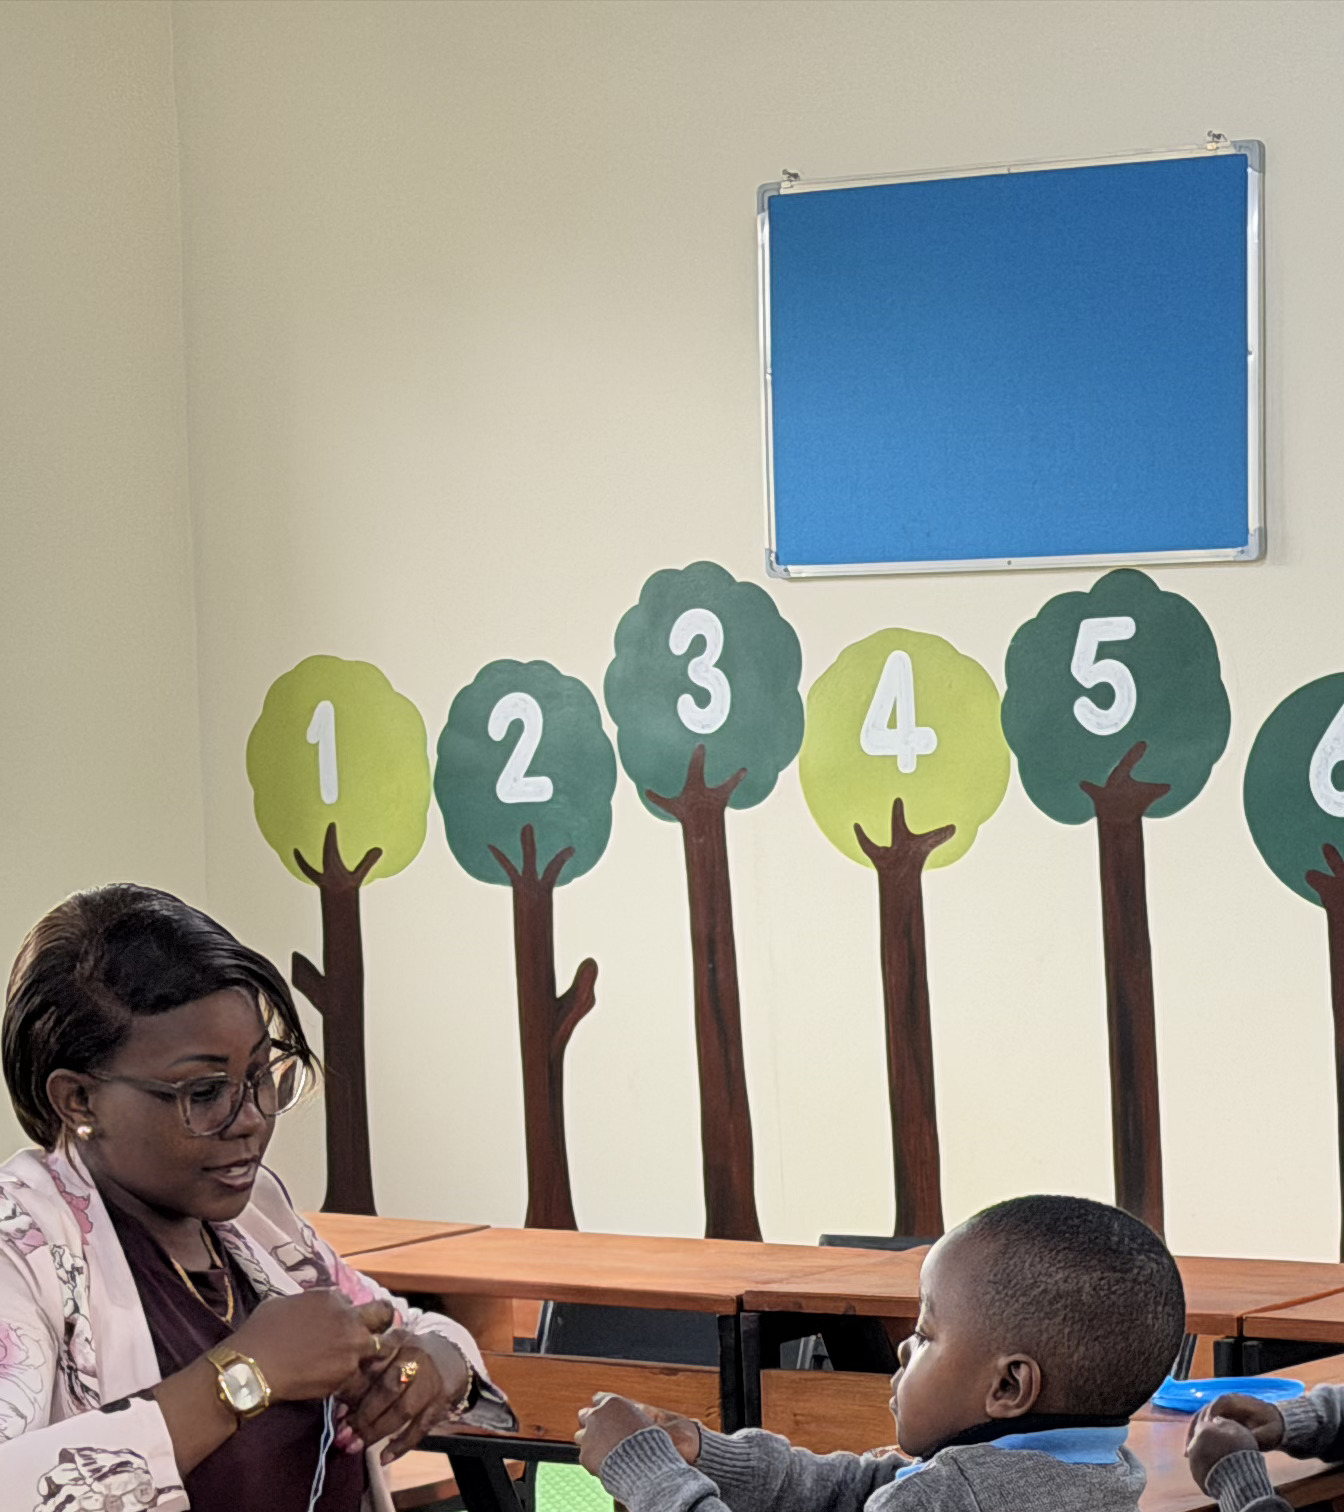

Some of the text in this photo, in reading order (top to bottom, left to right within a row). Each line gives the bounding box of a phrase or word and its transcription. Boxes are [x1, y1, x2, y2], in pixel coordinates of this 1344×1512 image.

[669, 608, 731, 734] 3
[860, 650, 938, 773] 4
[1071, 616, 1136, 735] 5
[306, 700, 339, 805] 1
[488, 692, 553, 803] 2
